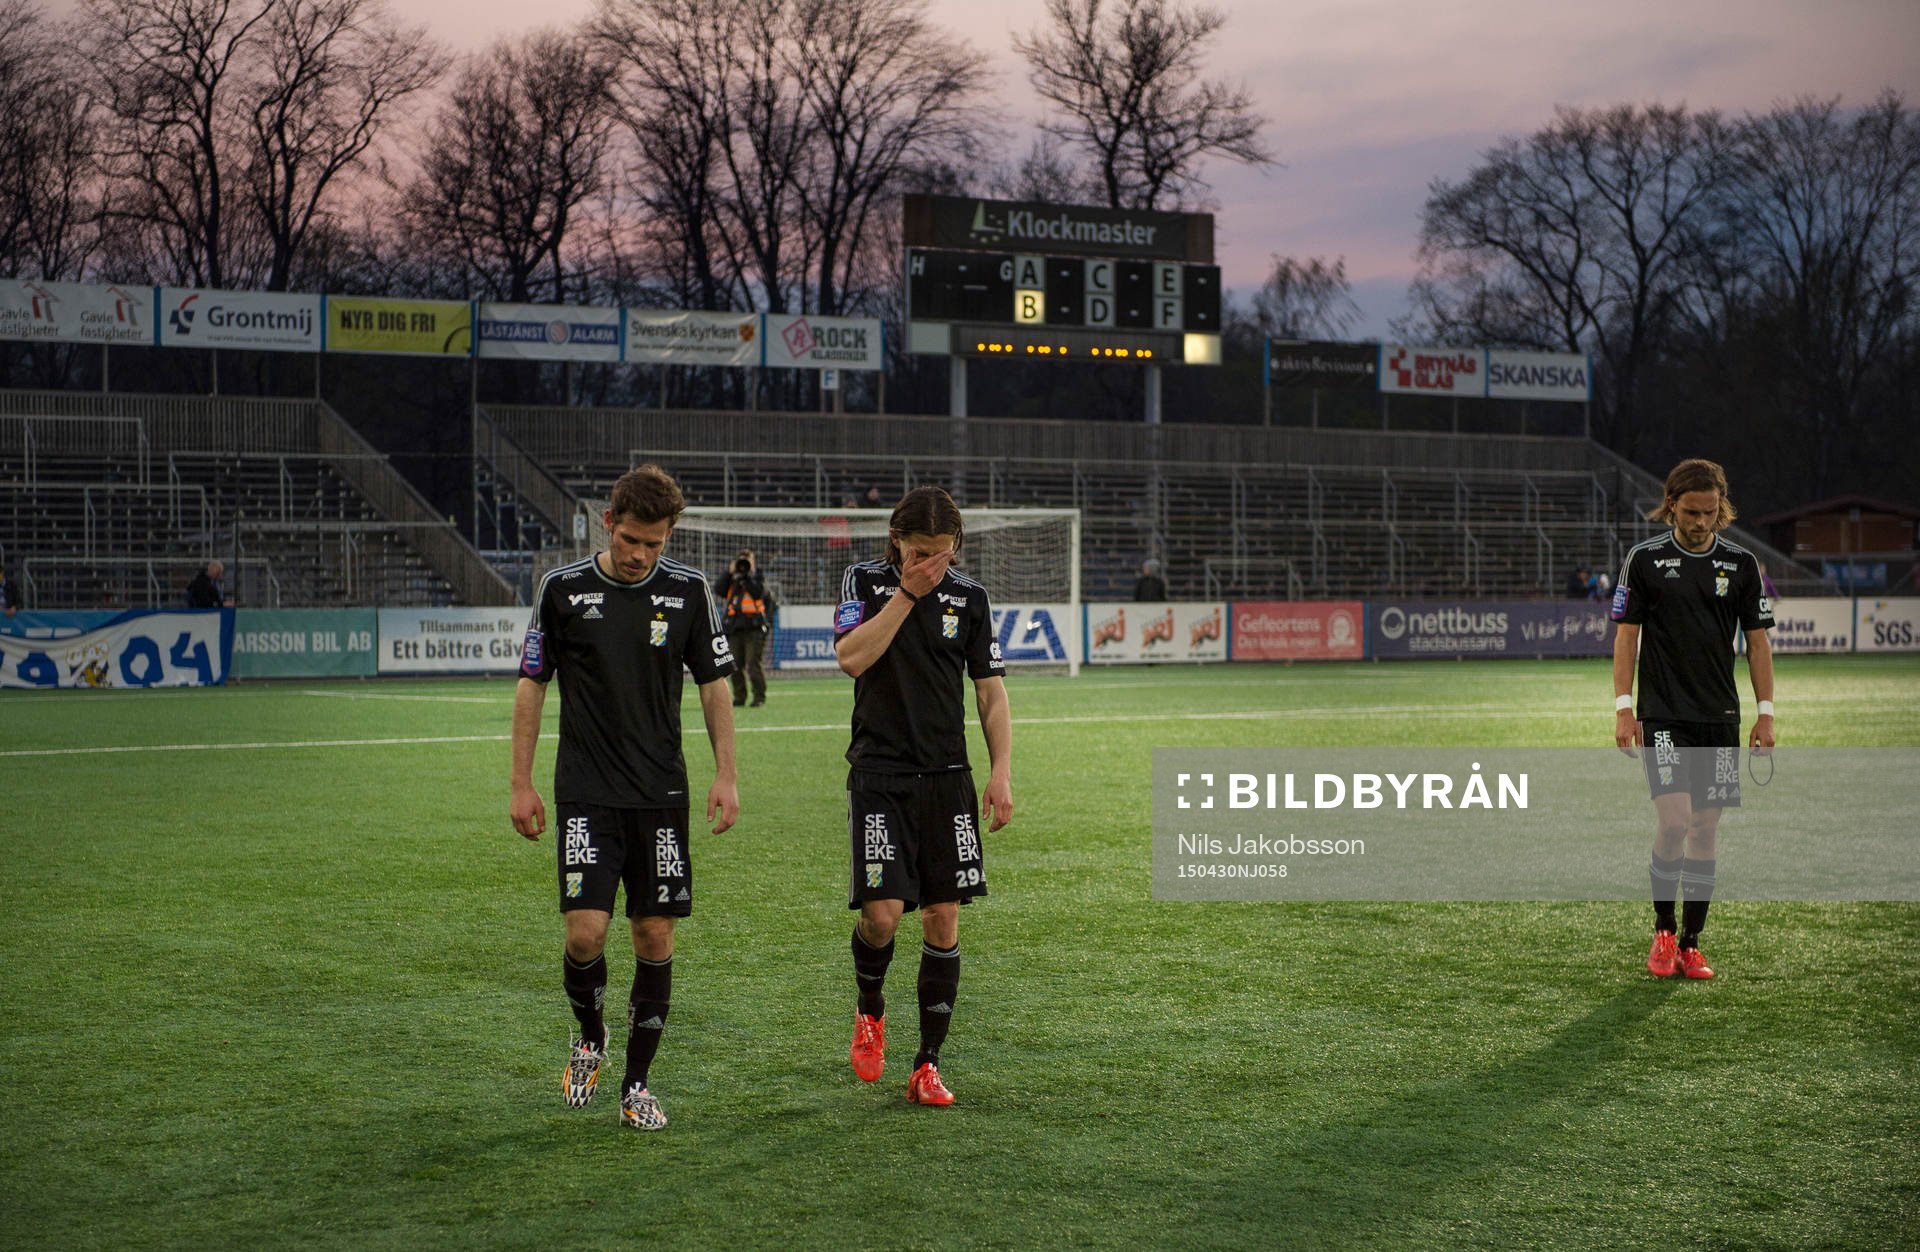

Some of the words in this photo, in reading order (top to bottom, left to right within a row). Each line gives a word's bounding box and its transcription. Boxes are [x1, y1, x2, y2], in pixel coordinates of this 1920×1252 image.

[1007, 210, 1156, 246] Klockmaster
[911, 256, 925, 276] H
[1021, 260, 1039, 285] A
[1093, 264, 1108, 289] C
[1163, 268, 1175, 292] E
[1022, 295, 1037, 319] B
[1092, 299, 1108, 323] D
[1163, 302, 1175, 325] F
[207, 305, 312, 336] Grontmij
[378, 311, 406, 331] DIG
[411, 313, 436, 333] FRI
[811, 326, 867, 349] ROCK
[1490, 363, 1586, 388] SKANSKA
[420, 619, 495, 633] Tillsammans
[498, 619, 515, 632] för
[1409, 607, 1508, 634] nettbuss
[1874, 620, 1913, 646] SGS
[312, 631, 341, 653] BIL
[347, 631, 372, 652] AB
[393, 640, 418, 659] Ett
[425, 638, 483, 659] bättre
[1409, 635, 1506, 652] stadsbussarna
[1654, 731, 1671, 742] SE
[1655, 741, 1675, 754] RN
[1716, 747, 1732, 760] SE
[1656, 752, 1680, 765] EKE
[1716, 759, 1734, 771] RN
[1715, 770, 1738, 783] EKE
[1707, 786, 1728, 800] 24
[566, 817, 588, 833] SE
[865, 814, 886, 829] SE
[953, 814, 973, 831] SE
[566, 832, 589, 848] RN
[656, 828, 677, 844] SE
[865, 829, 888, 844] RN
[955, 829, 977, 846] RN
[566, 848, 598, 865] EKE
[656, 845, 679, 860] RN
[865, 844, 895, 860] EKE
[957, 845, 980, 862] EK
[657, 860, 684, 877] EKE
[955, 867, 980, 889] 29
[657, 884, 670, 903] 2
